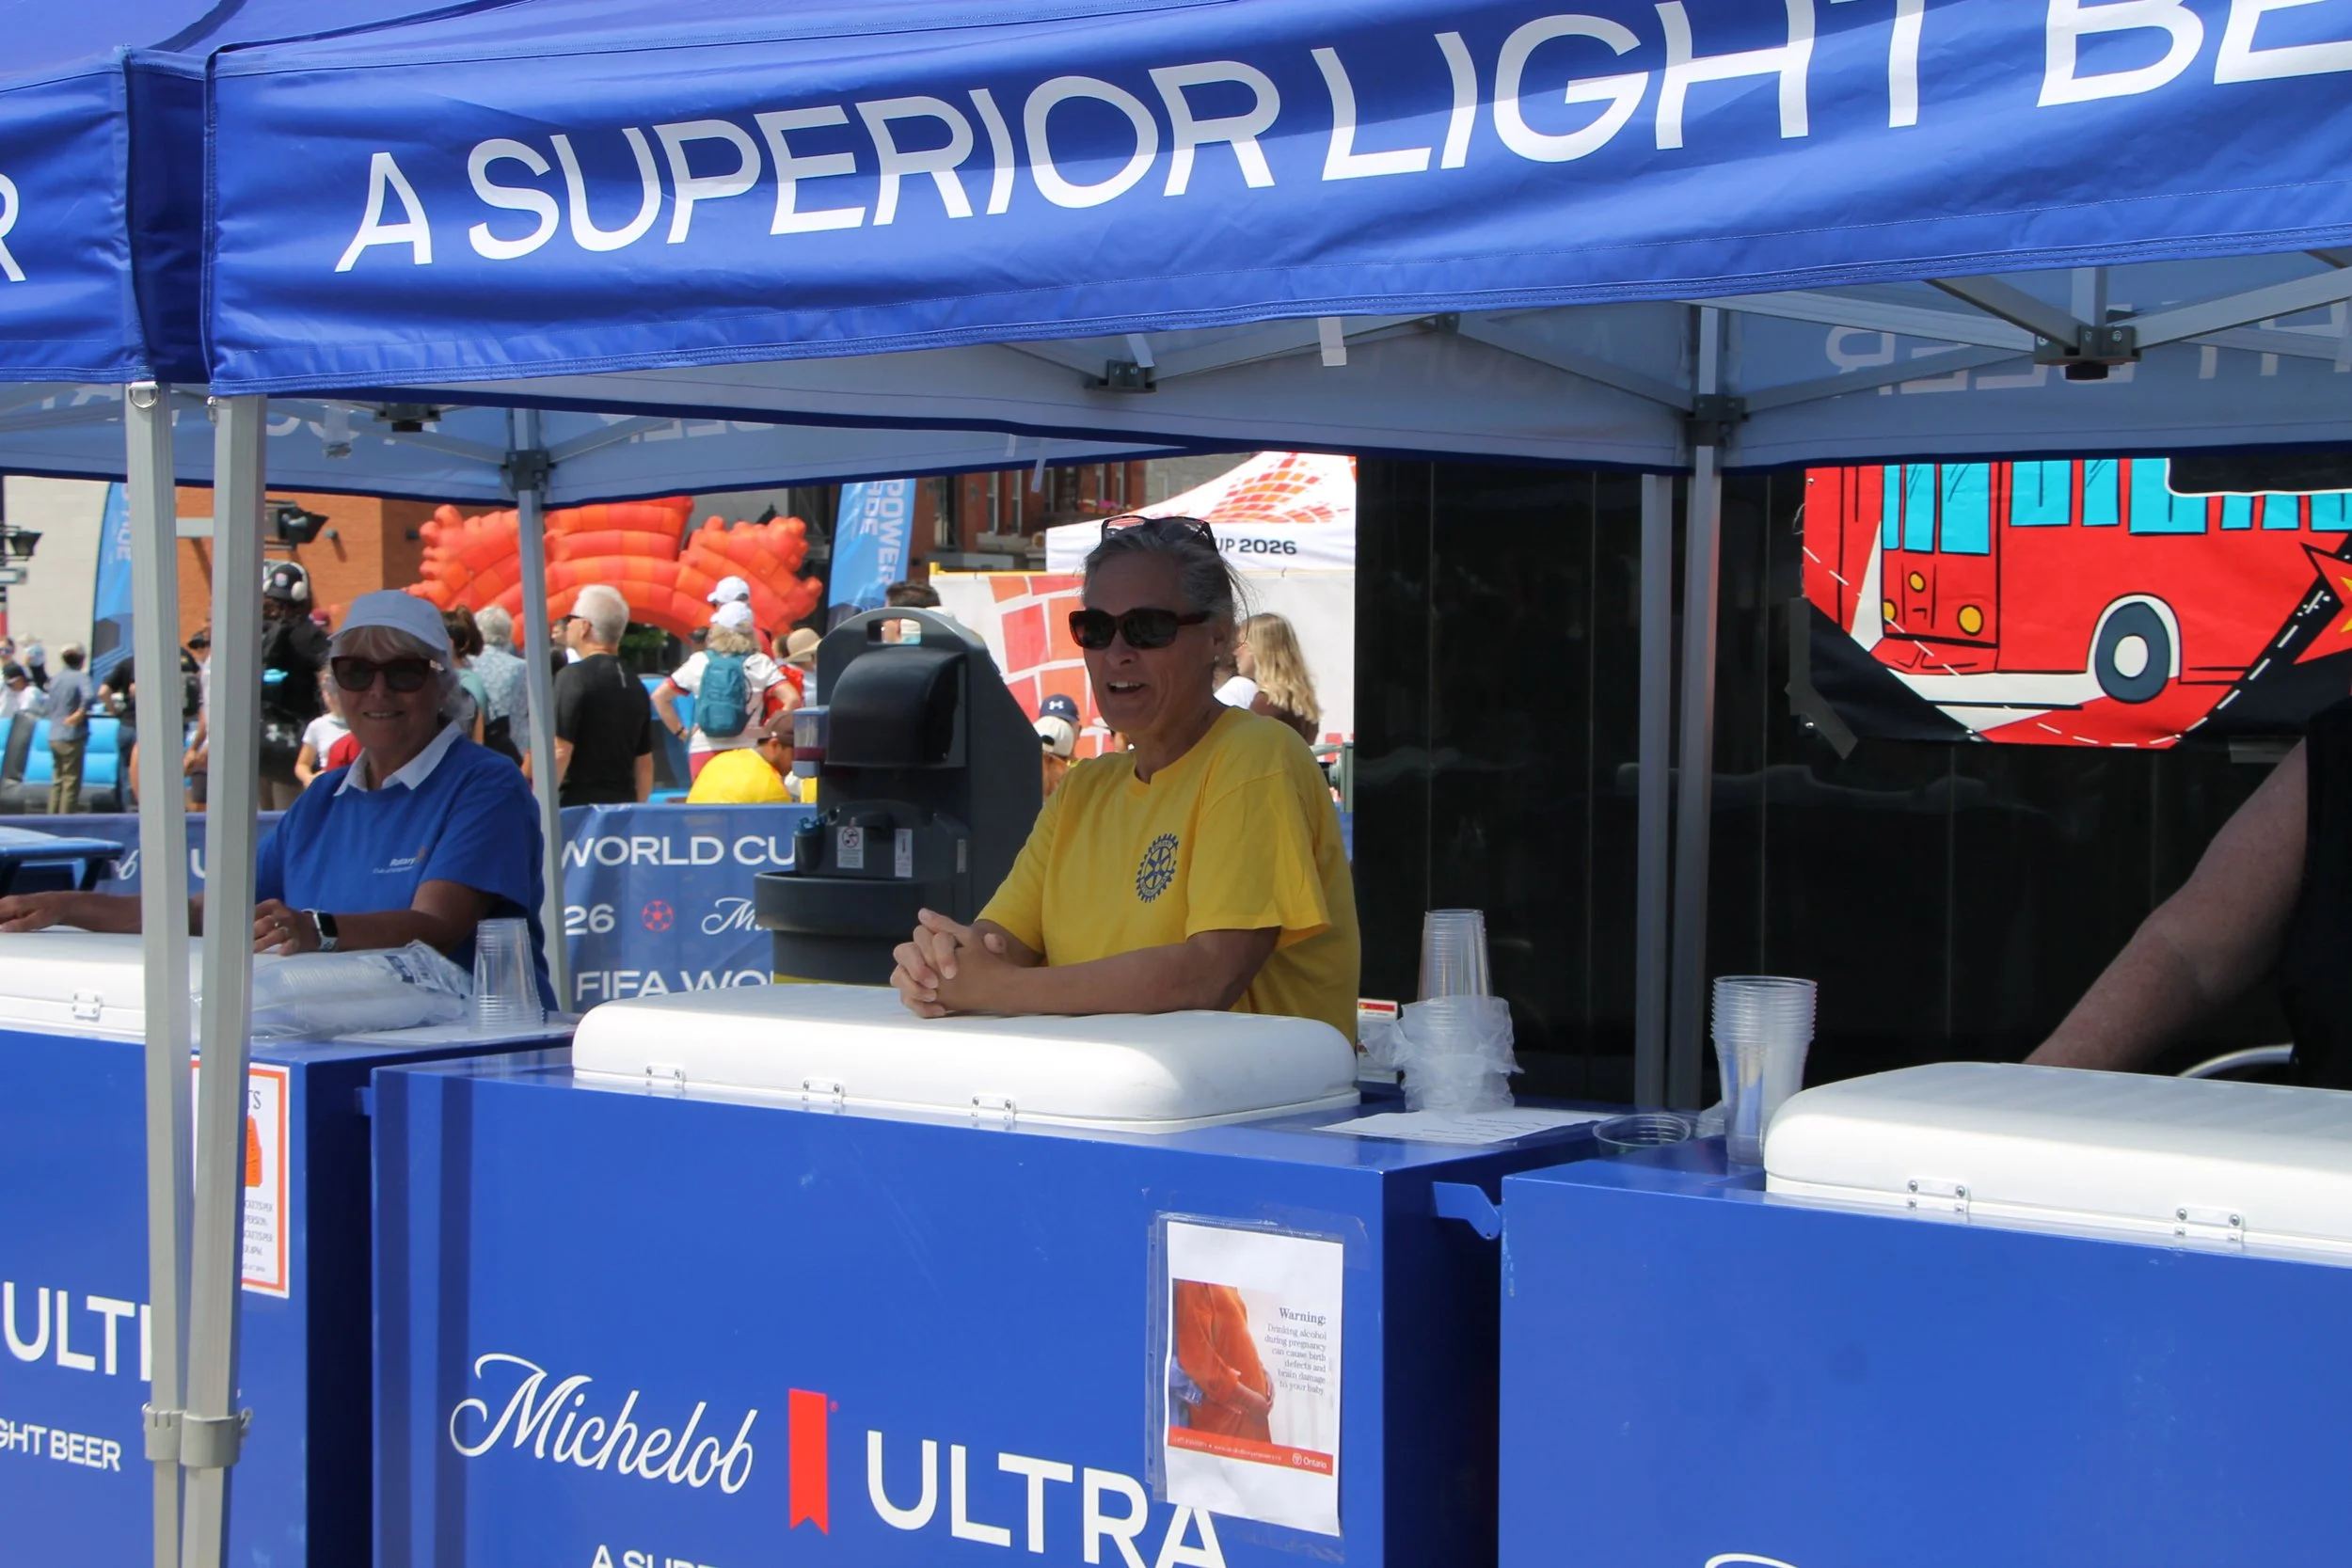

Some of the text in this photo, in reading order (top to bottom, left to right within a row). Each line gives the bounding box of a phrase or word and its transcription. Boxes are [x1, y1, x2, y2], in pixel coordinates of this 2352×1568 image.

[334, 151, 433, 274] A
[468, 59, 1281, 261] SUPERIOR
[1311, 0, 1926, 182] LIGHT
[879, 480, 905, 586] POWER
[1239, 538, 1297, 555] 2026
[562, 835, 724, 869] WORLD
[564, 903, 615, 936] 26
[576, 969, 774, 1001] FIFA WO
[1279, 1307, 1327, 1326] Warning:
[1267, 1323, 1327, 1340] Drinking alcohol
[1264, 1335, 1327, 1353] during pregnancy
[1272, 1347, 1327, 1362] can cause birth
[1284, 1359, 1327, 1373] defects and
[1278, 1369, 1327, 1385] brain damage
[1279, 1380, 1288, 1388] to
[1288, 1382, 1307, 1392] your
[50, 1428, 121, 1472] BEER
[450, 1353, 1229, 1568] Michelob ULTRA
[1303, 1457, 1327, 1469] Ontario
